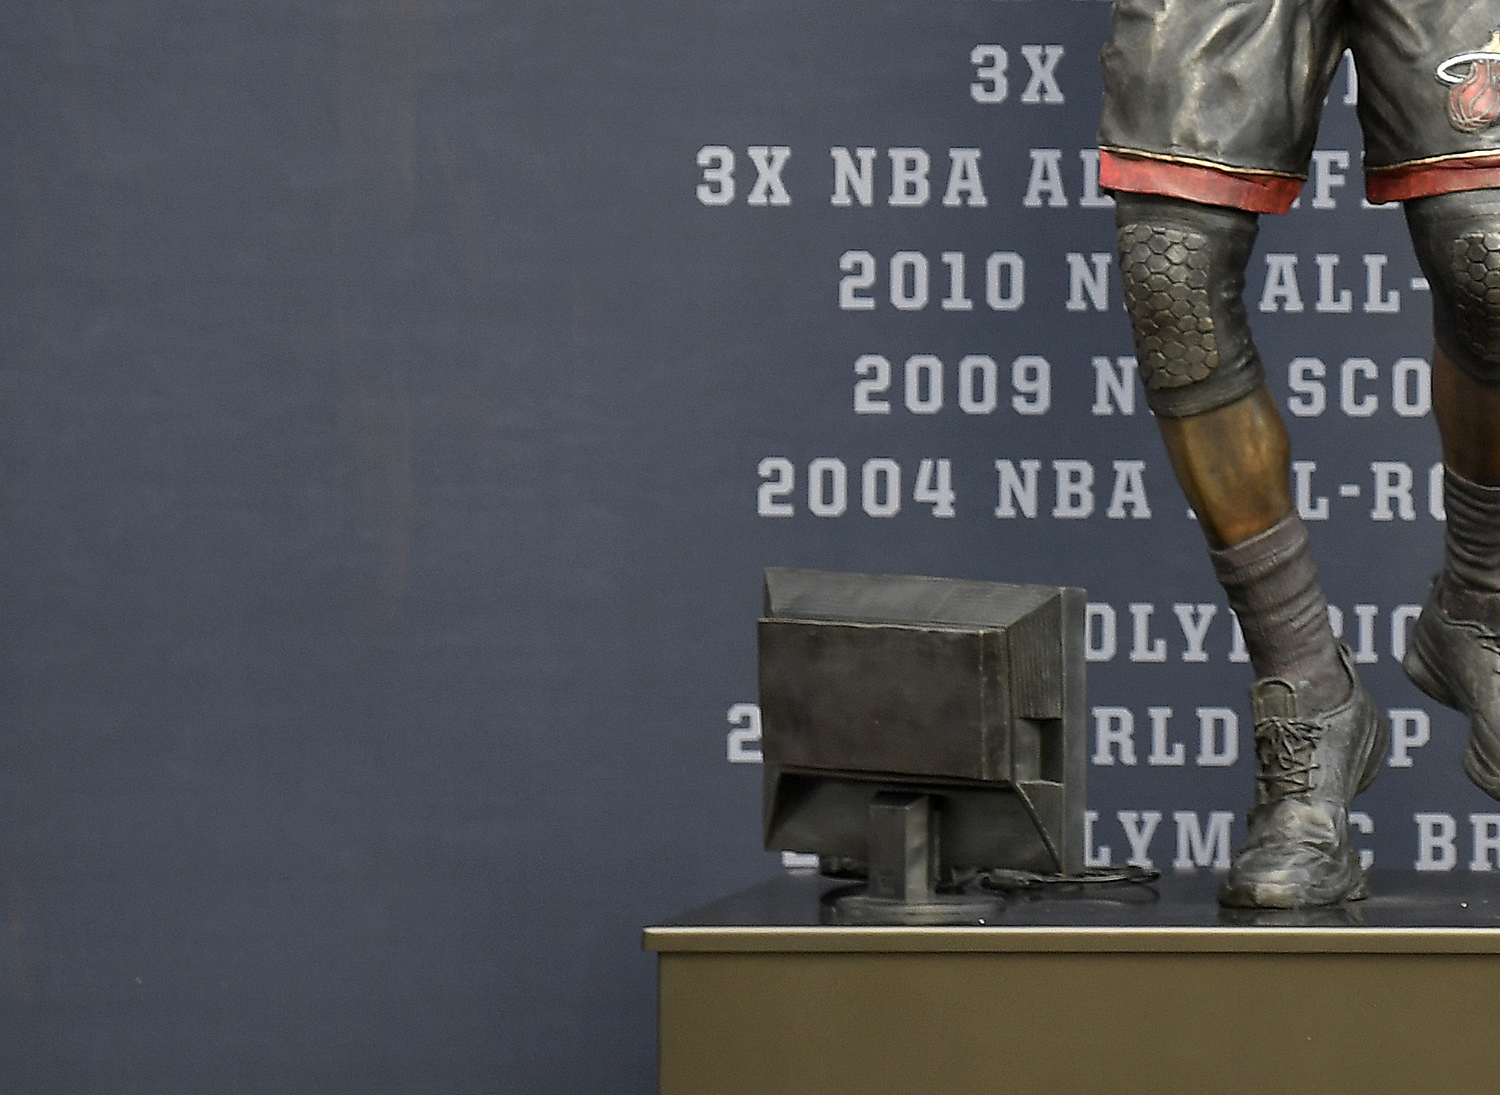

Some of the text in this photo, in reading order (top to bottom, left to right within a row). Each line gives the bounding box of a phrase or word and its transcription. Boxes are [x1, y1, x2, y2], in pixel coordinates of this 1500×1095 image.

[970, 44, 1065, 105] 3X
[696, 145, 792, 206] 3X
[830, 147, 988, 207] NBA
[838, 250, 1025, 310] 2010
[854, 354, 1052, 415] 2009
[757, 457, 957, 518] 2004
[995, 459, 1153, 519] NBA
[1092, 707, 1239, 767] RLD
